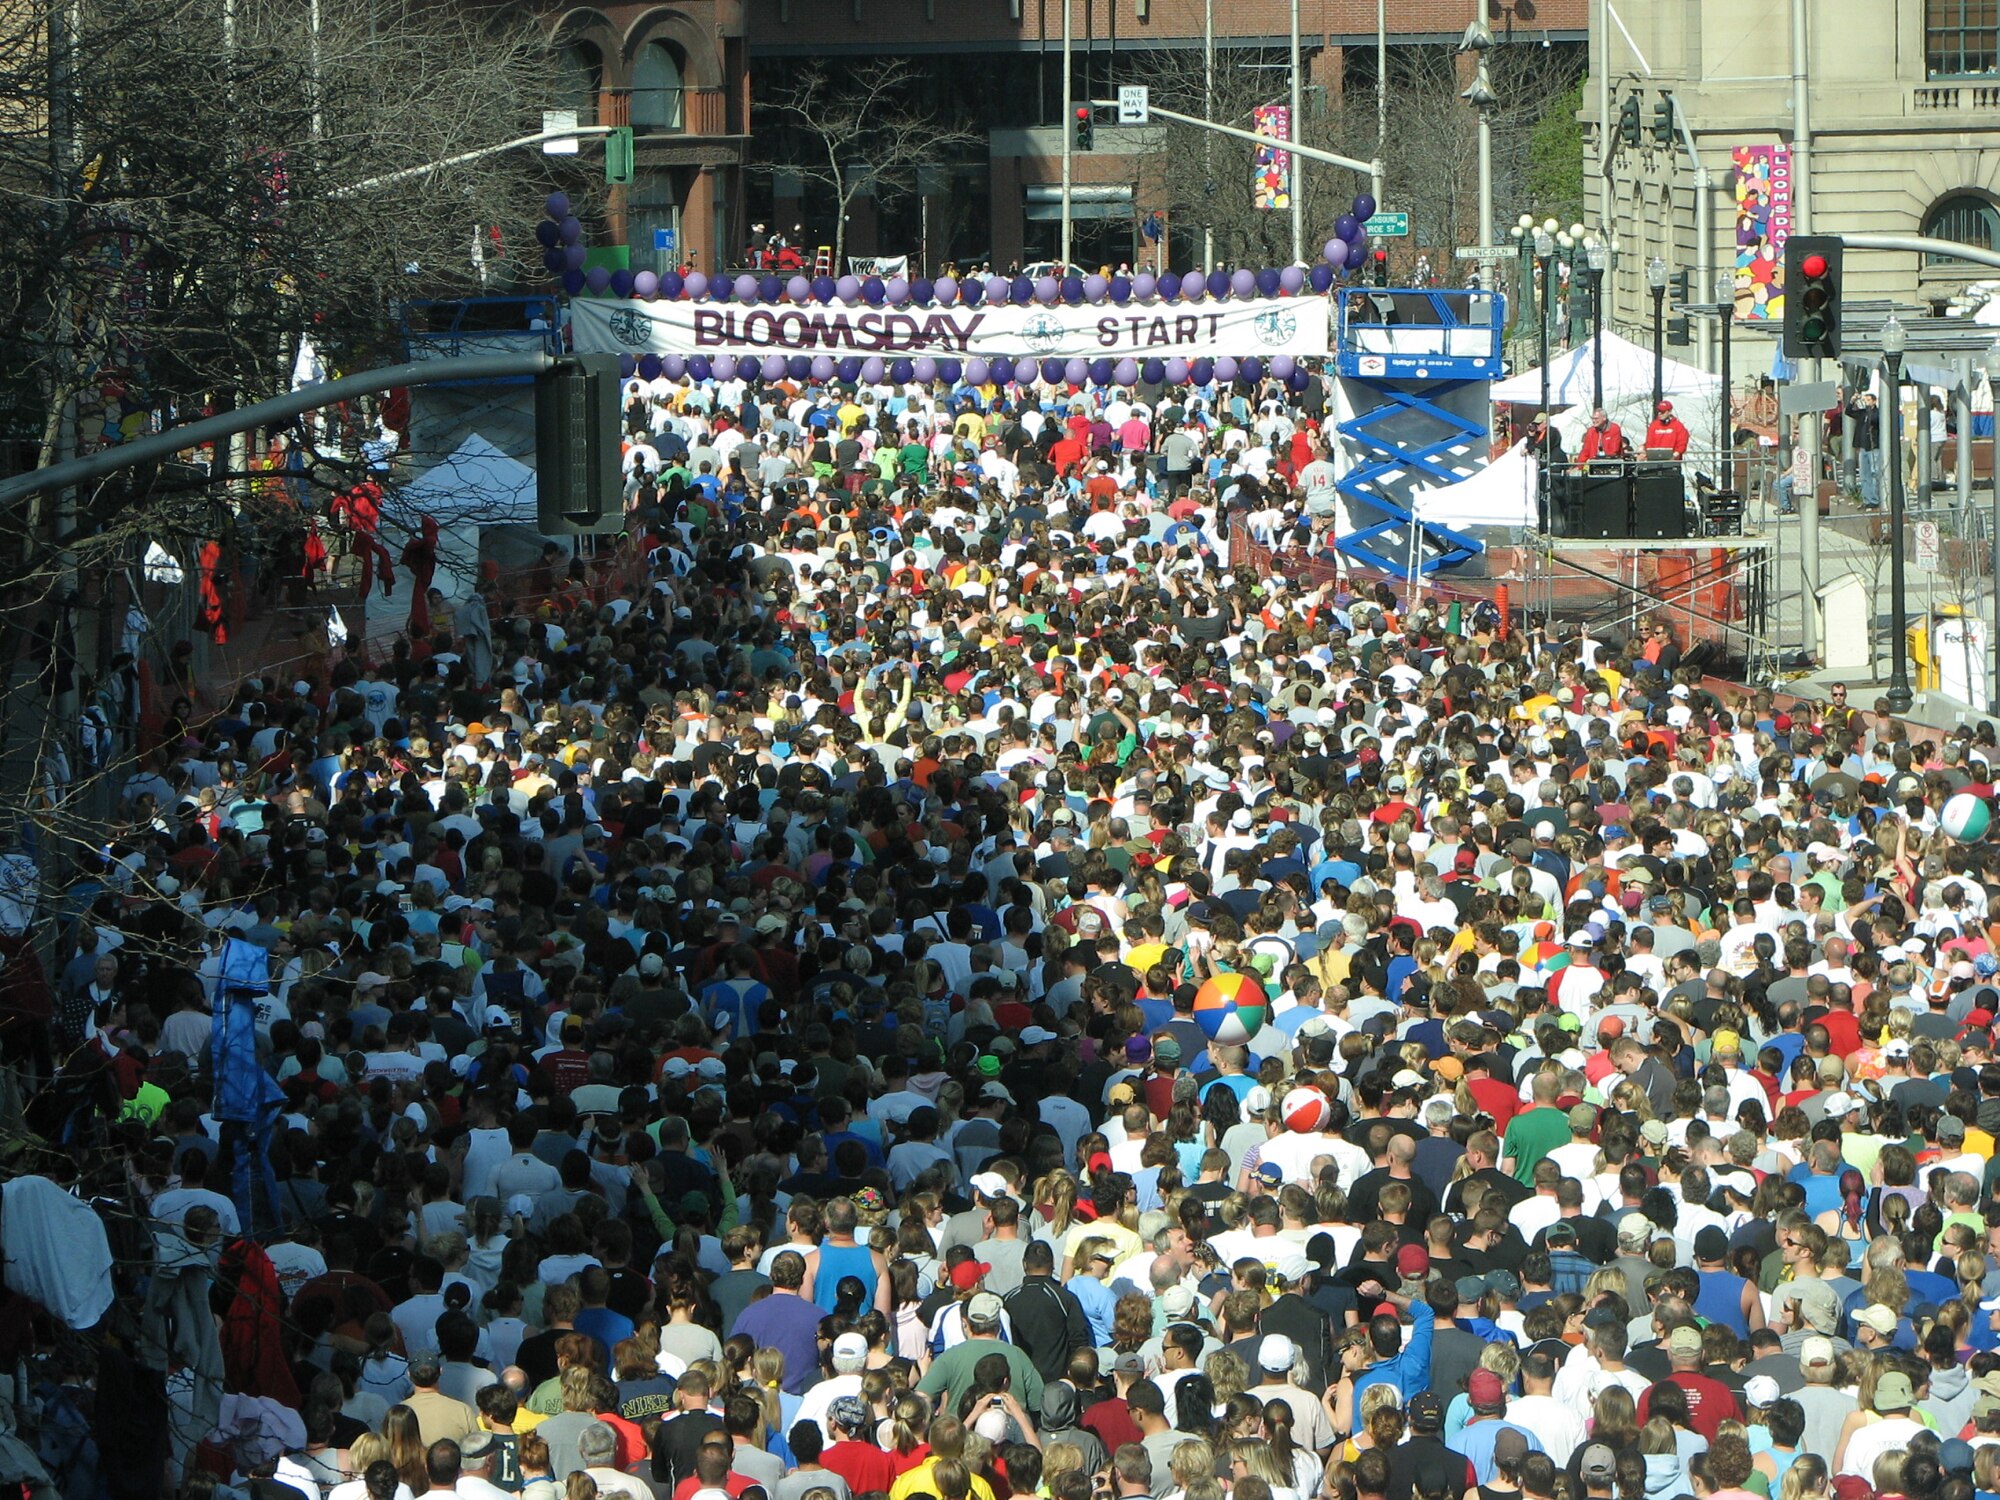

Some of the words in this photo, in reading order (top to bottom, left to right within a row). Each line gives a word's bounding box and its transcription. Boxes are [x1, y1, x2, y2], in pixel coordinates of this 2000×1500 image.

[1124, 90, 1143, 99] ONE
[1278, 106, 1286, 167] BLOOMDAY
[1774, 144, 1788, 248] BLOOMSDAY
[1467, 249, 1508, 257] LINCOLN
[694, 310, 984, 352] BLOOMSDAY
[1097, 313, 1224, 346] START
[1312, 474, 1325, 487] 14
[622, 1394, 670, 1416] NIKE
